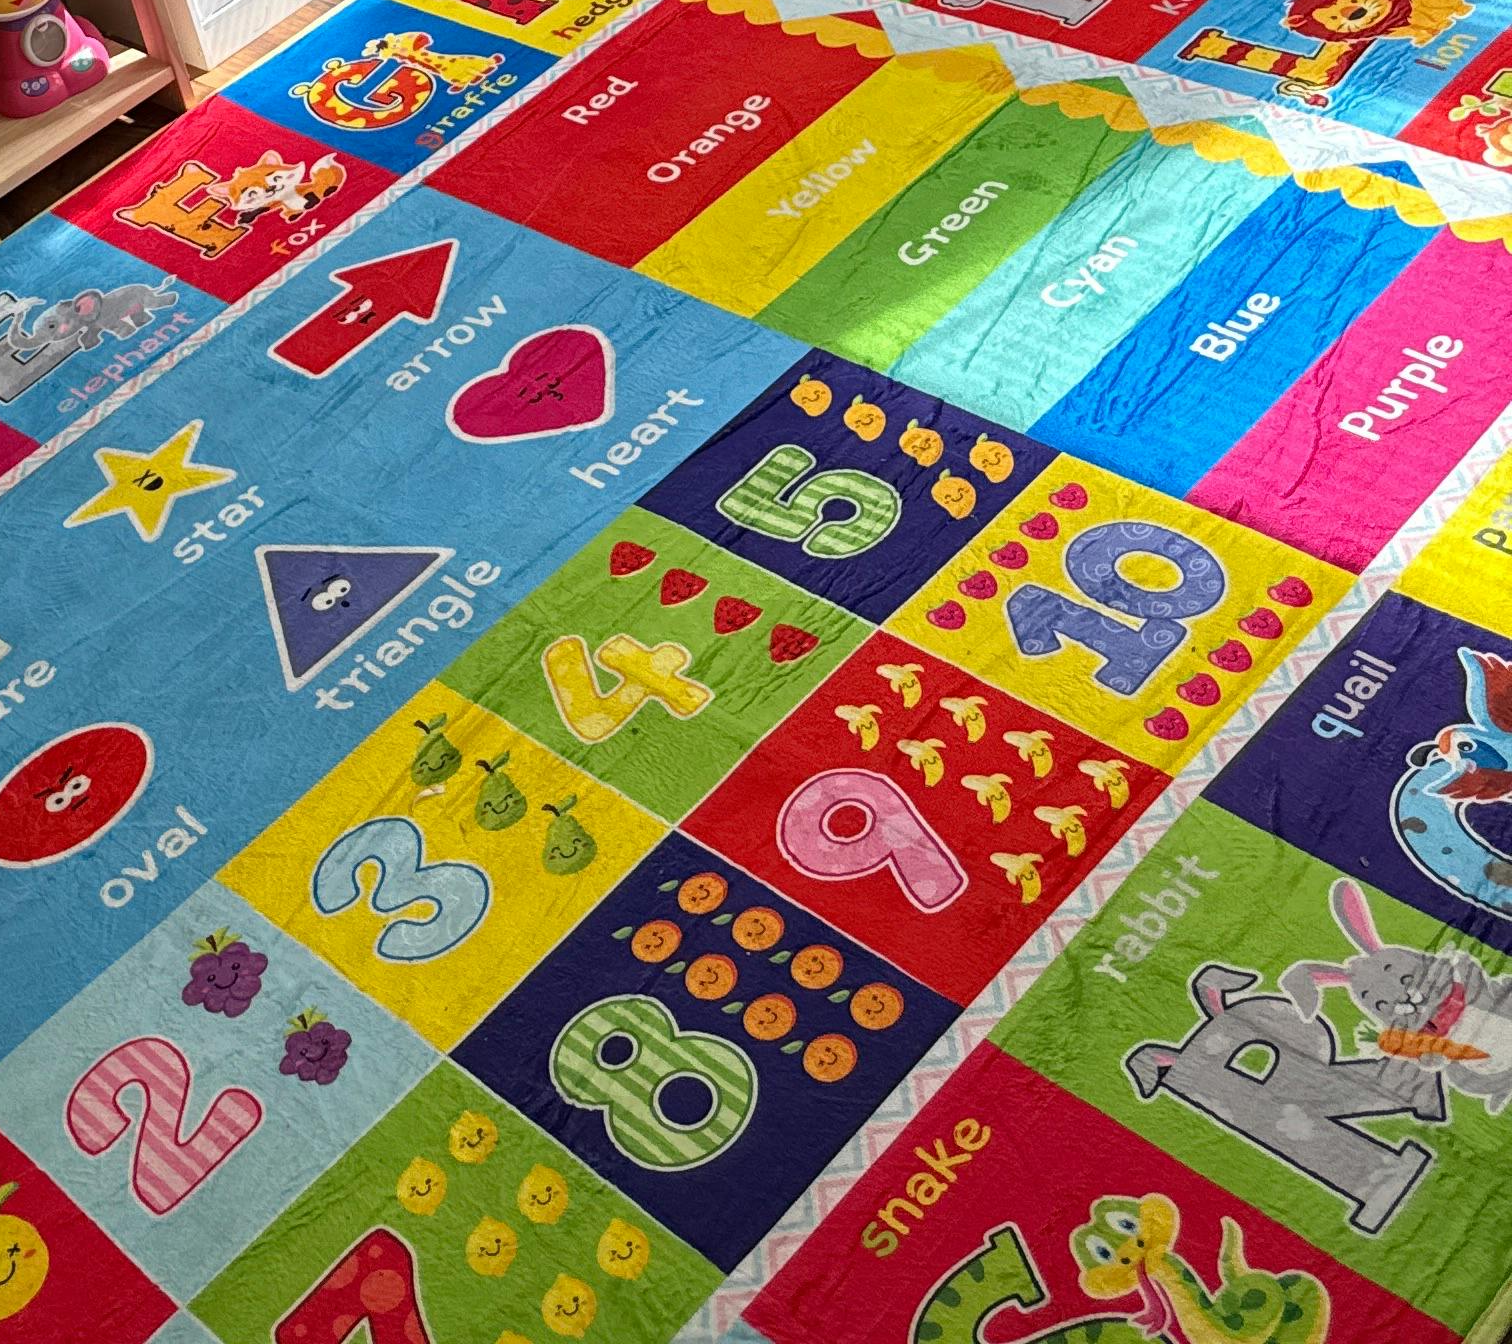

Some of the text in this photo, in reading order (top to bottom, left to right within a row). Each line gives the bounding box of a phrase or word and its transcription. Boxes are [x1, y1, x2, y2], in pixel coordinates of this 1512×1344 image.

[289, 55, 438, 134] G
[561, 73, 638, 127] Red
[1177, 25, 1366, 107] L
[1414, 29, 1479, 75] lion
[414, 69, 518, 152] giraffe
[645, 90, 772, 189] Orange
[113, 160, 254, 260] F
[766, 136, 877, 226] Yellow
[898, 177, 1010, 269] Green
[269, 215, 328, 259] fox
[1040, 233, 1139, 312] Cyan
[55, 307, 196, 415] elephant
[386, 293, 509, 393] arrow
[1189, 286, 1282, 365] Blue
[1336, 331, 1466, 442] Purple
[570, 387, 706, 491] heart
[172, 483, 266, 566] star
[716, 442, 904, 559] 5
[314, 558, 502, 713] triangle
[1000, 519, 1230, 697] 10
[543, 632, 714, 745] 4
[1310, 648, 1398, 743] quail
[98, 804, 209, 909] oval
[312, 815, 490, 963] 3
[777, 766, 972, 914] 9
[1091, 849, 1219, 985] rabbit
[67, 1036, 265, 1216] 2
[547, 992, 759, 1174] 8
[1122, 961, 1449, 1236] R
[860, 1114, 993, 1260] snake
